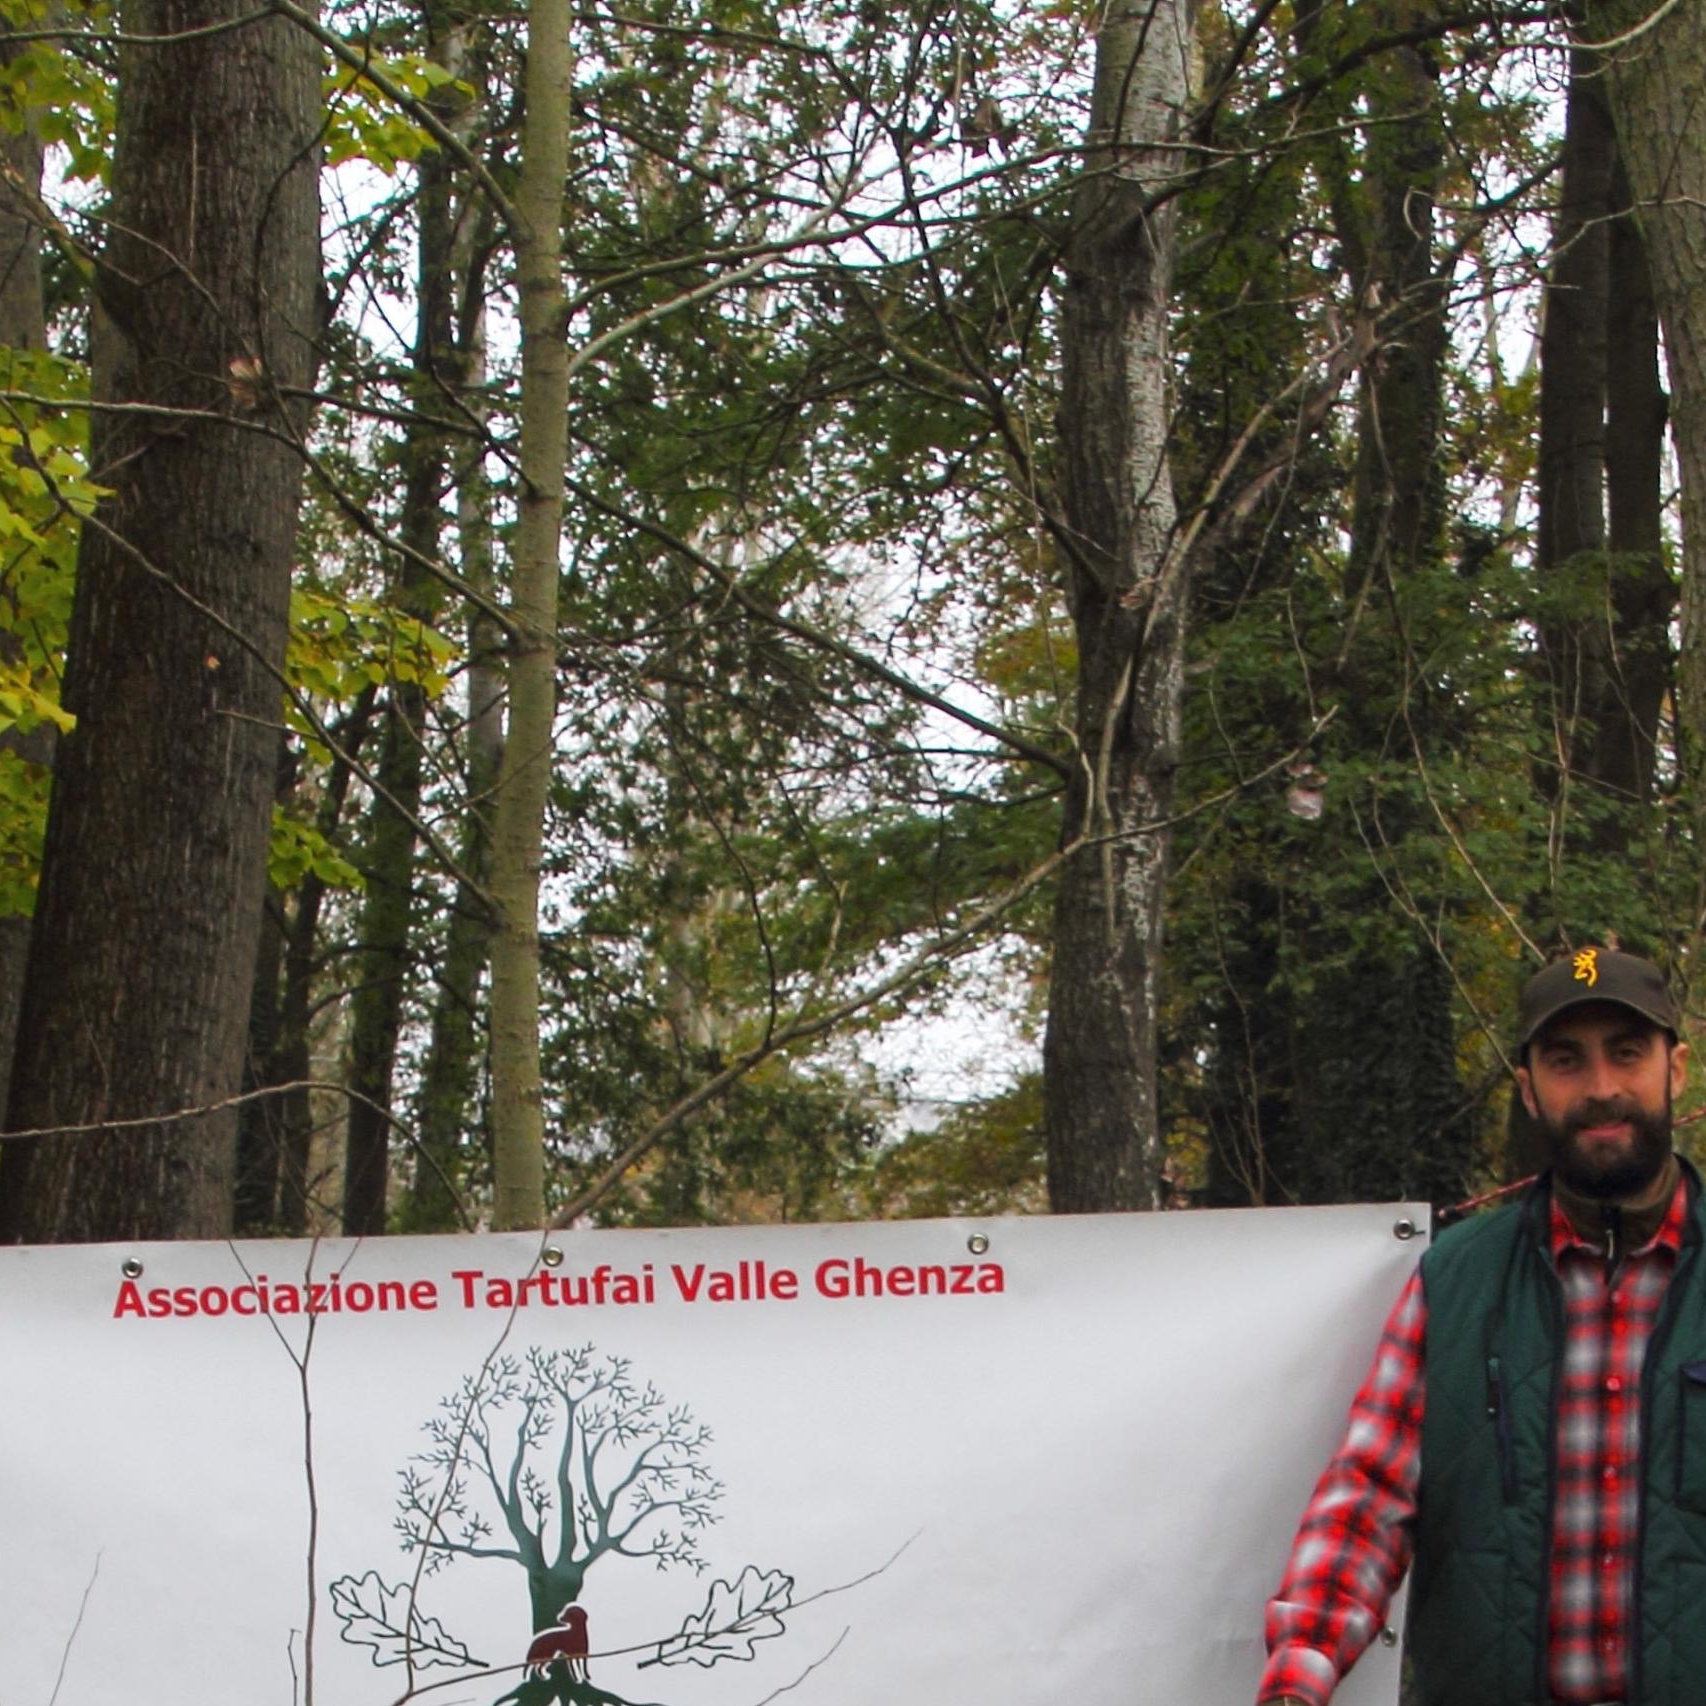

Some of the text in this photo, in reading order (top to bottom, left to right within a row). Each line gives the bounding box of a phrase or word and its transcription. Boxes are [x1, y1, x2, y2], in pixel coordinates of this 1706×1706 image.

[113, 1257, 1005, 1318] Associazione Tartufai Valle Ghenza
